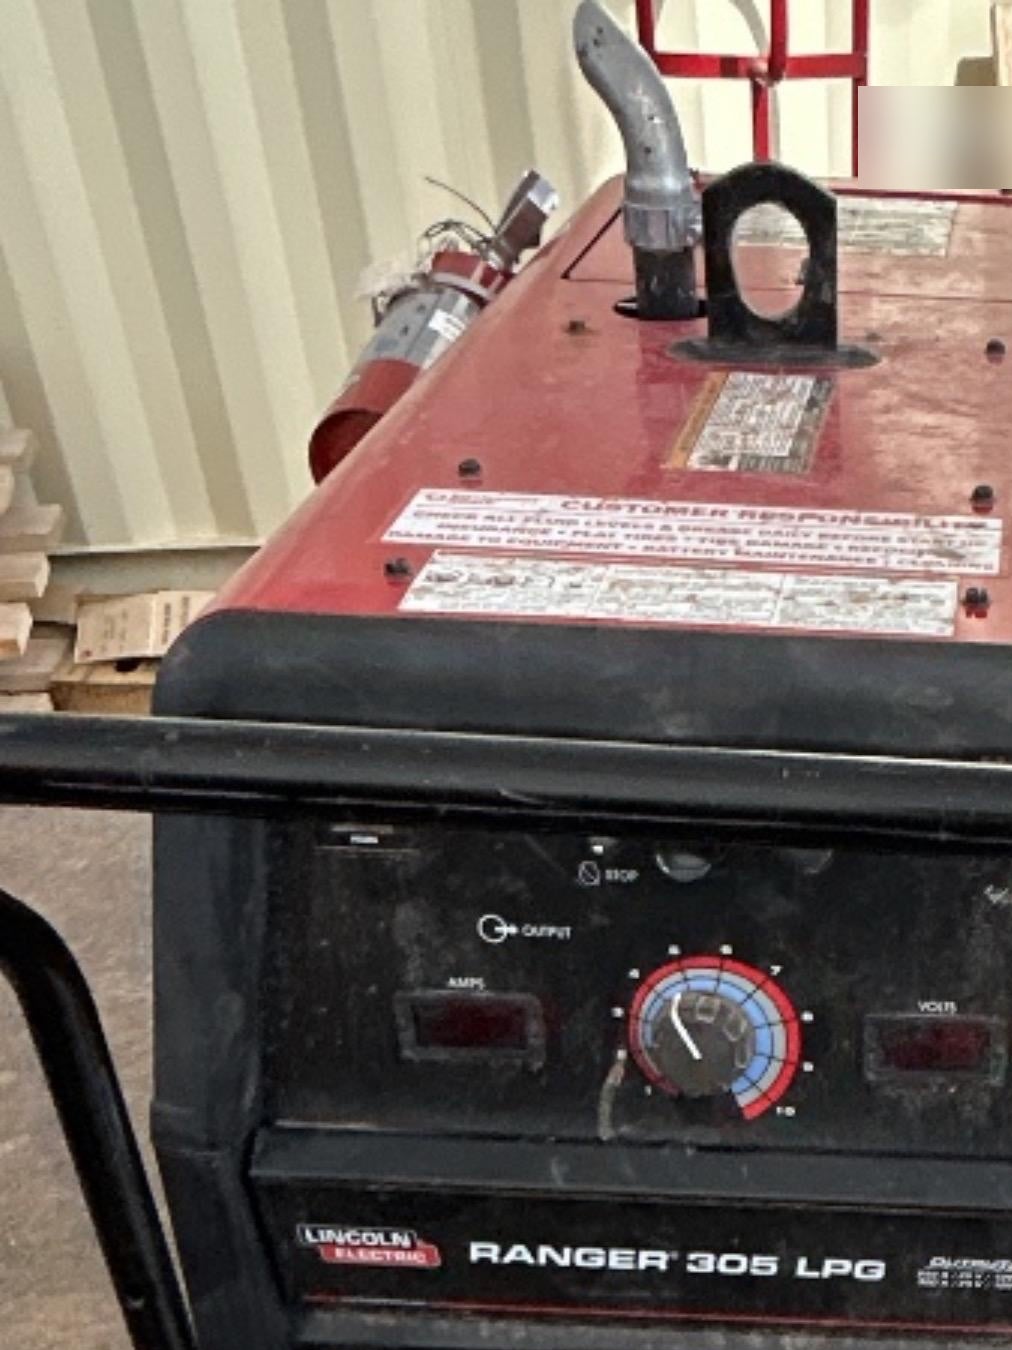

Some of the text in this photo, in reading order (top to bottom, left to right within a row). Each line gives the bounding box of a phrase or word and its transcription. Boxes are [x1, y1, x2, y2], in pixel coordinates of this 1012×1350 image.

[560, 499, 729, 518] CUSTOMER
[521, 924, 572, 940] OUTPUT
[448, 977, 486, 990] AMPS
[917, 1001, 957, 1014] VOLTS
[304, 1229, 412, 1248] LINCOLN
[334, 1247, 427, 1263] ELECTRIC
[469, 1241, 887, 1281] RANGER 305 LPG
